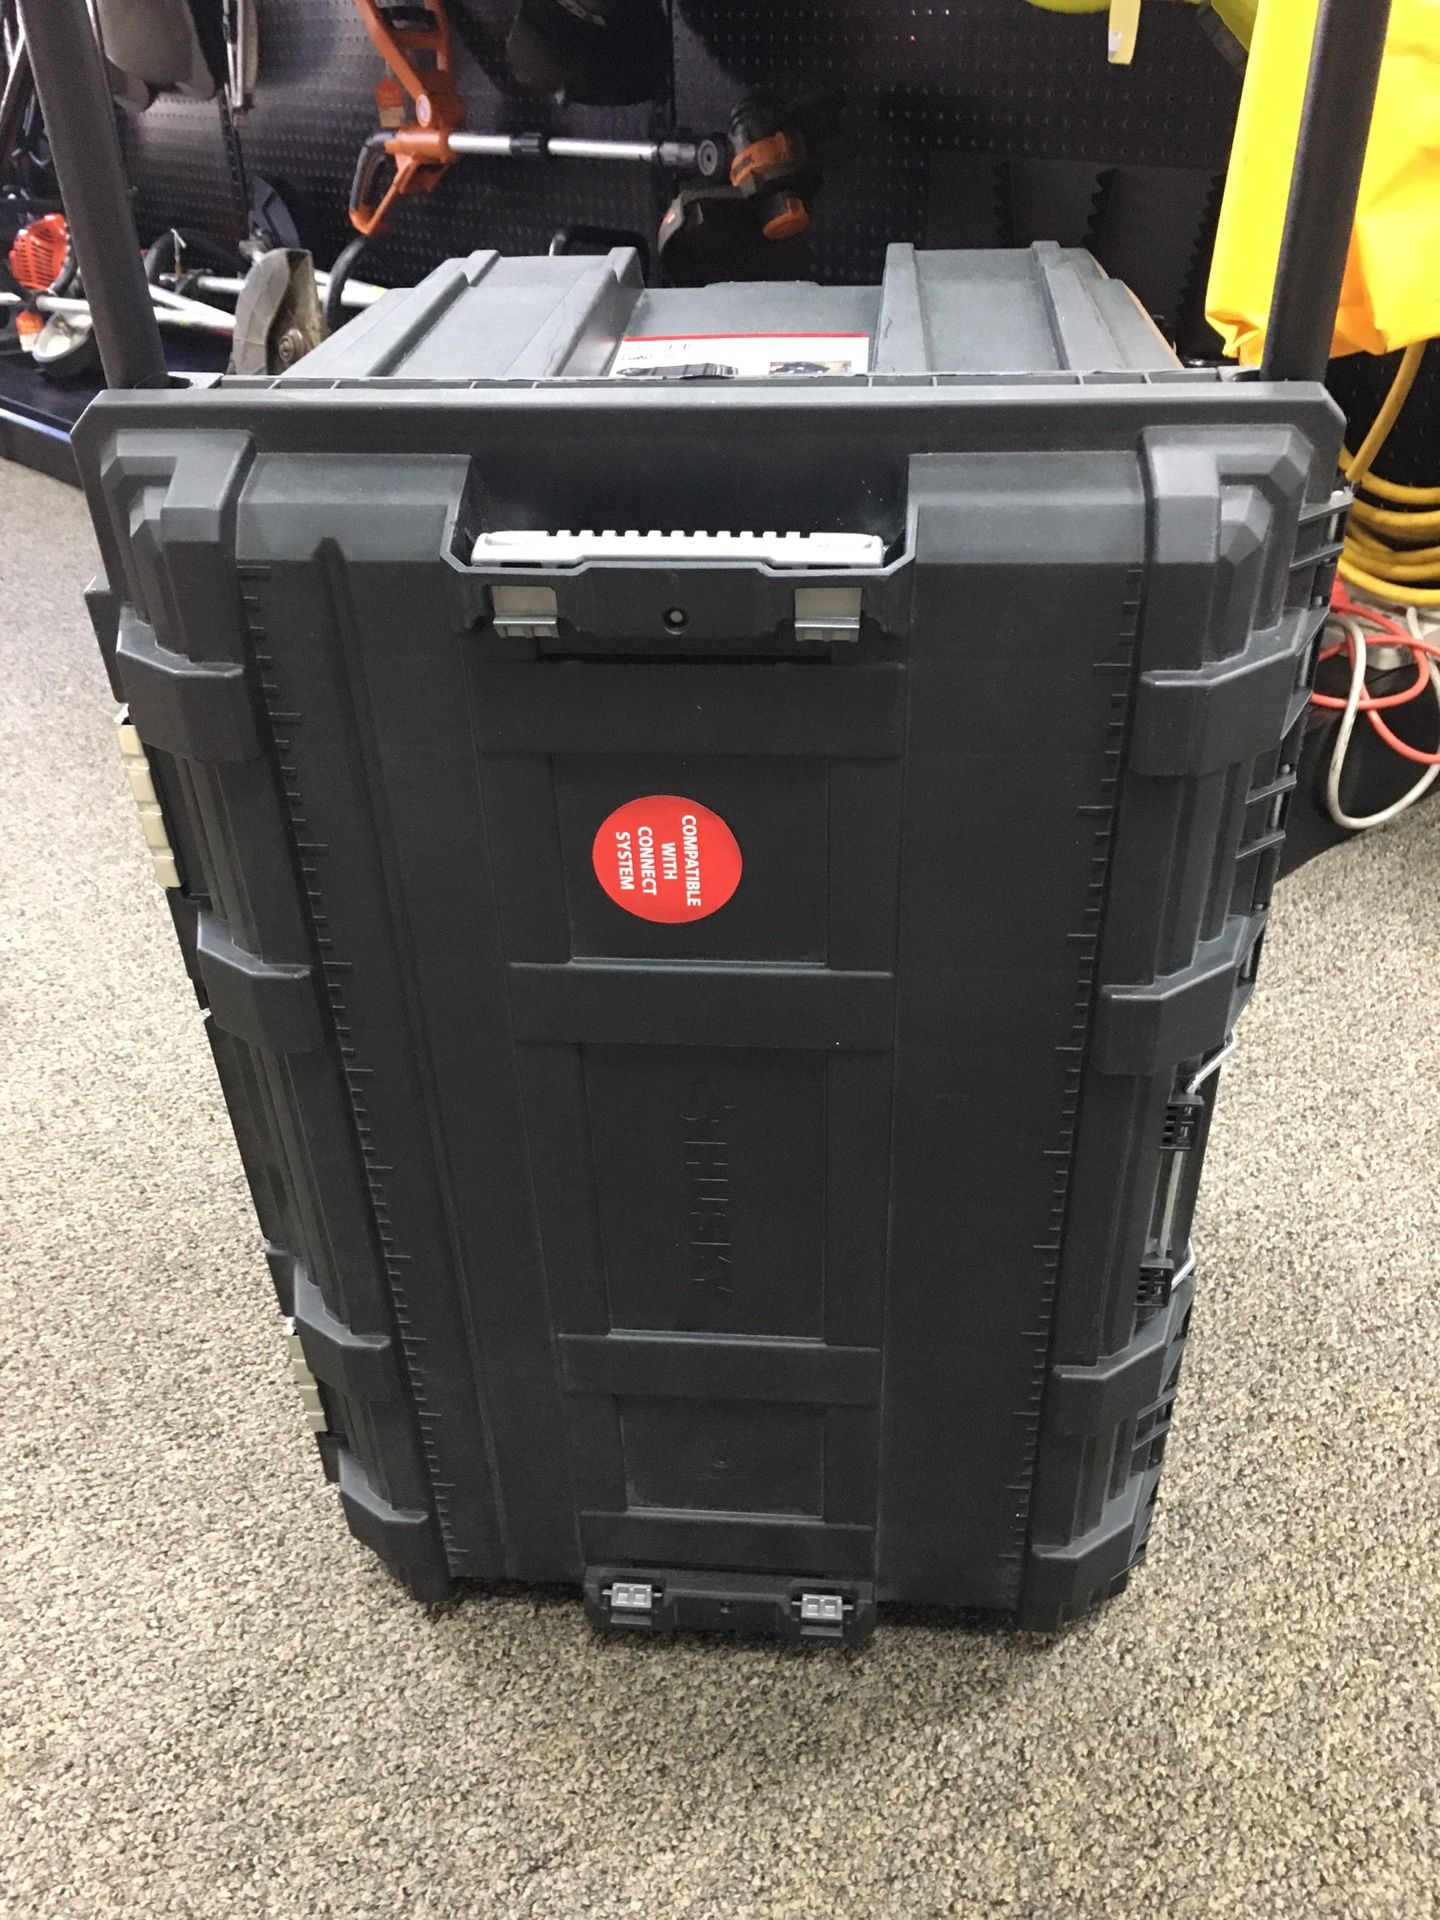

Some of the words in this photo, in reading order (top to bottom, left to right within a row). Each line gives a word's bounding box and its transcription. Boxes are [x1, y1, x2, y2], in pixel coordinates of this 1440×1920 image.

[615, 831, 635, 890] SYSTEM
[637, 826, 657, 896] CONNECT
[661, 841, 678, 880] WITH
[681, 814, 702, 907] COMPATIBLE
